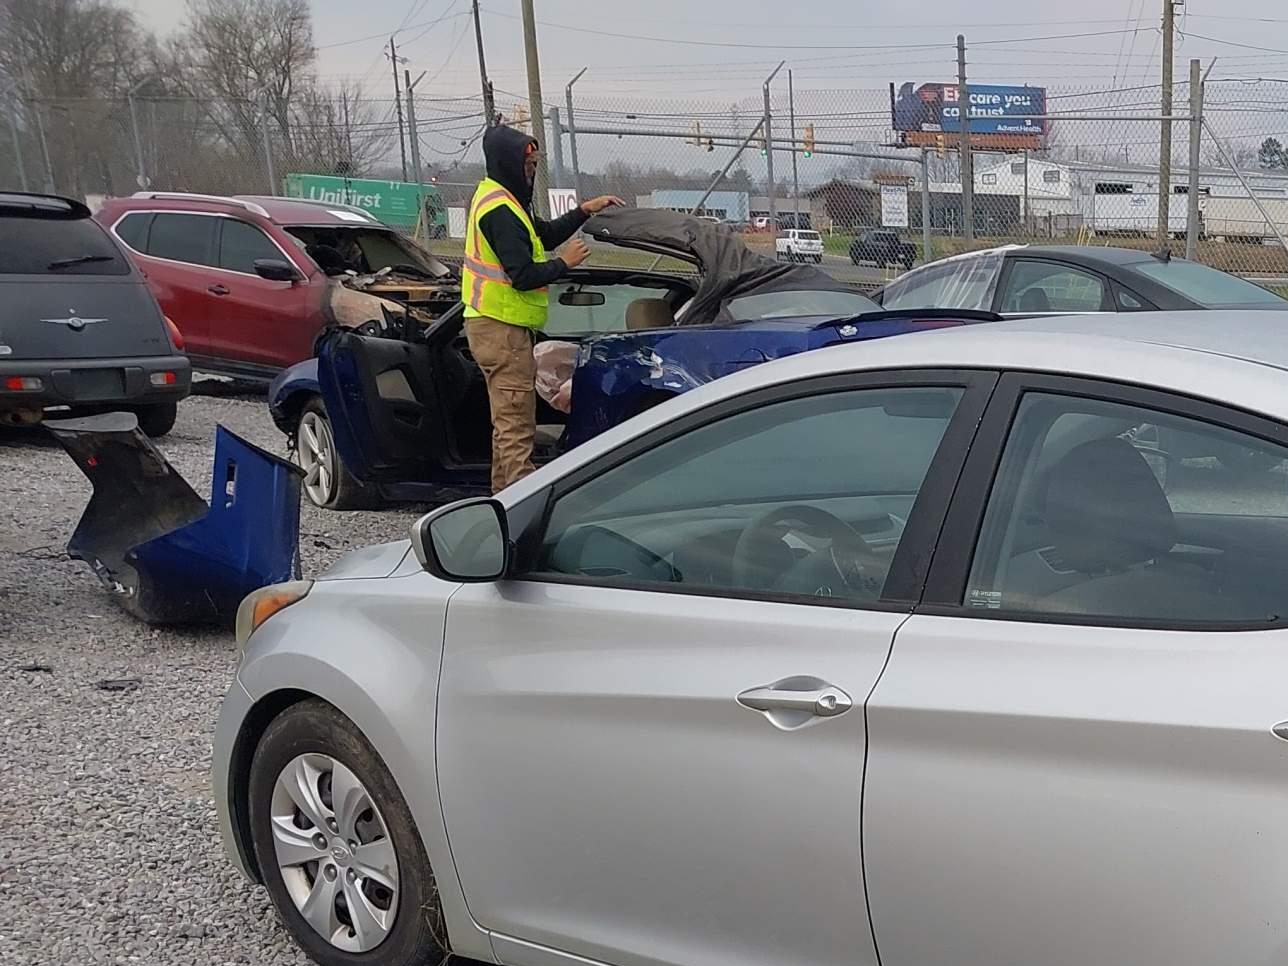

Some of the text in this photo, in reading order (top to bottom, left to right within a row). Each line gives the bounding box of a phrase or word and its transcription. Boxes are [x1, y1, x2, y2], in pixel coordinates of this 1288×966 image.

[969, 93, 1001, 104] care
[1004, 95, 1031, 108] you
[942, 105, 1005, 117] ca trust
[309, 186, 382, 208] UniFirst
